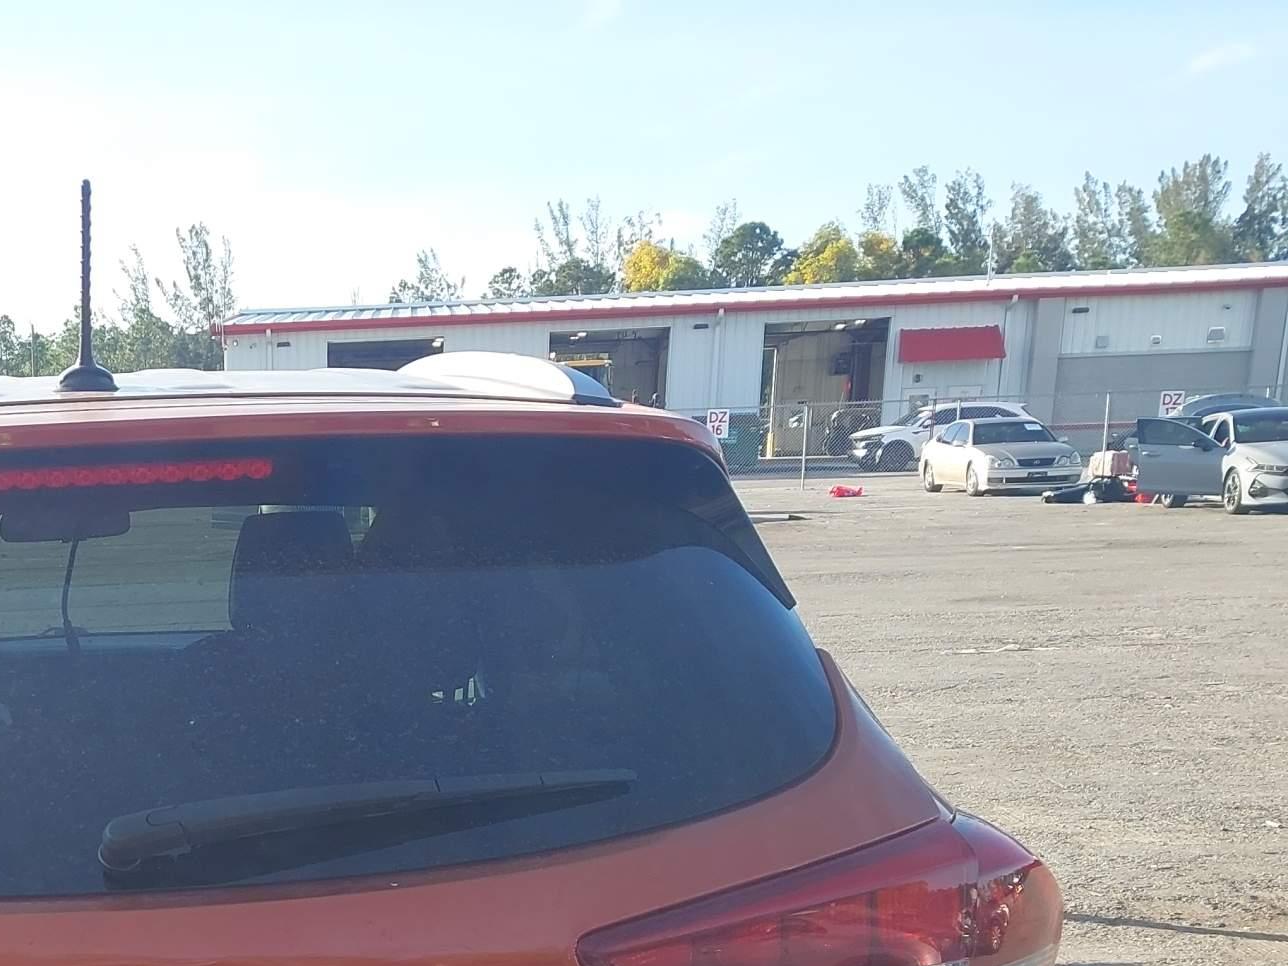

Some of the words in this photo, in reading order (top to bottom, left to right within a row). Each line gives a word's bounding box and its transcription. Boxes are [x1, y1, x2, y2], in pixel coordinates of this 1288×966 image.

[1162, 393, 1183, 405] DZ
[709, 411, 728, 424] DZ
[711, 424, 723, 436] 16
